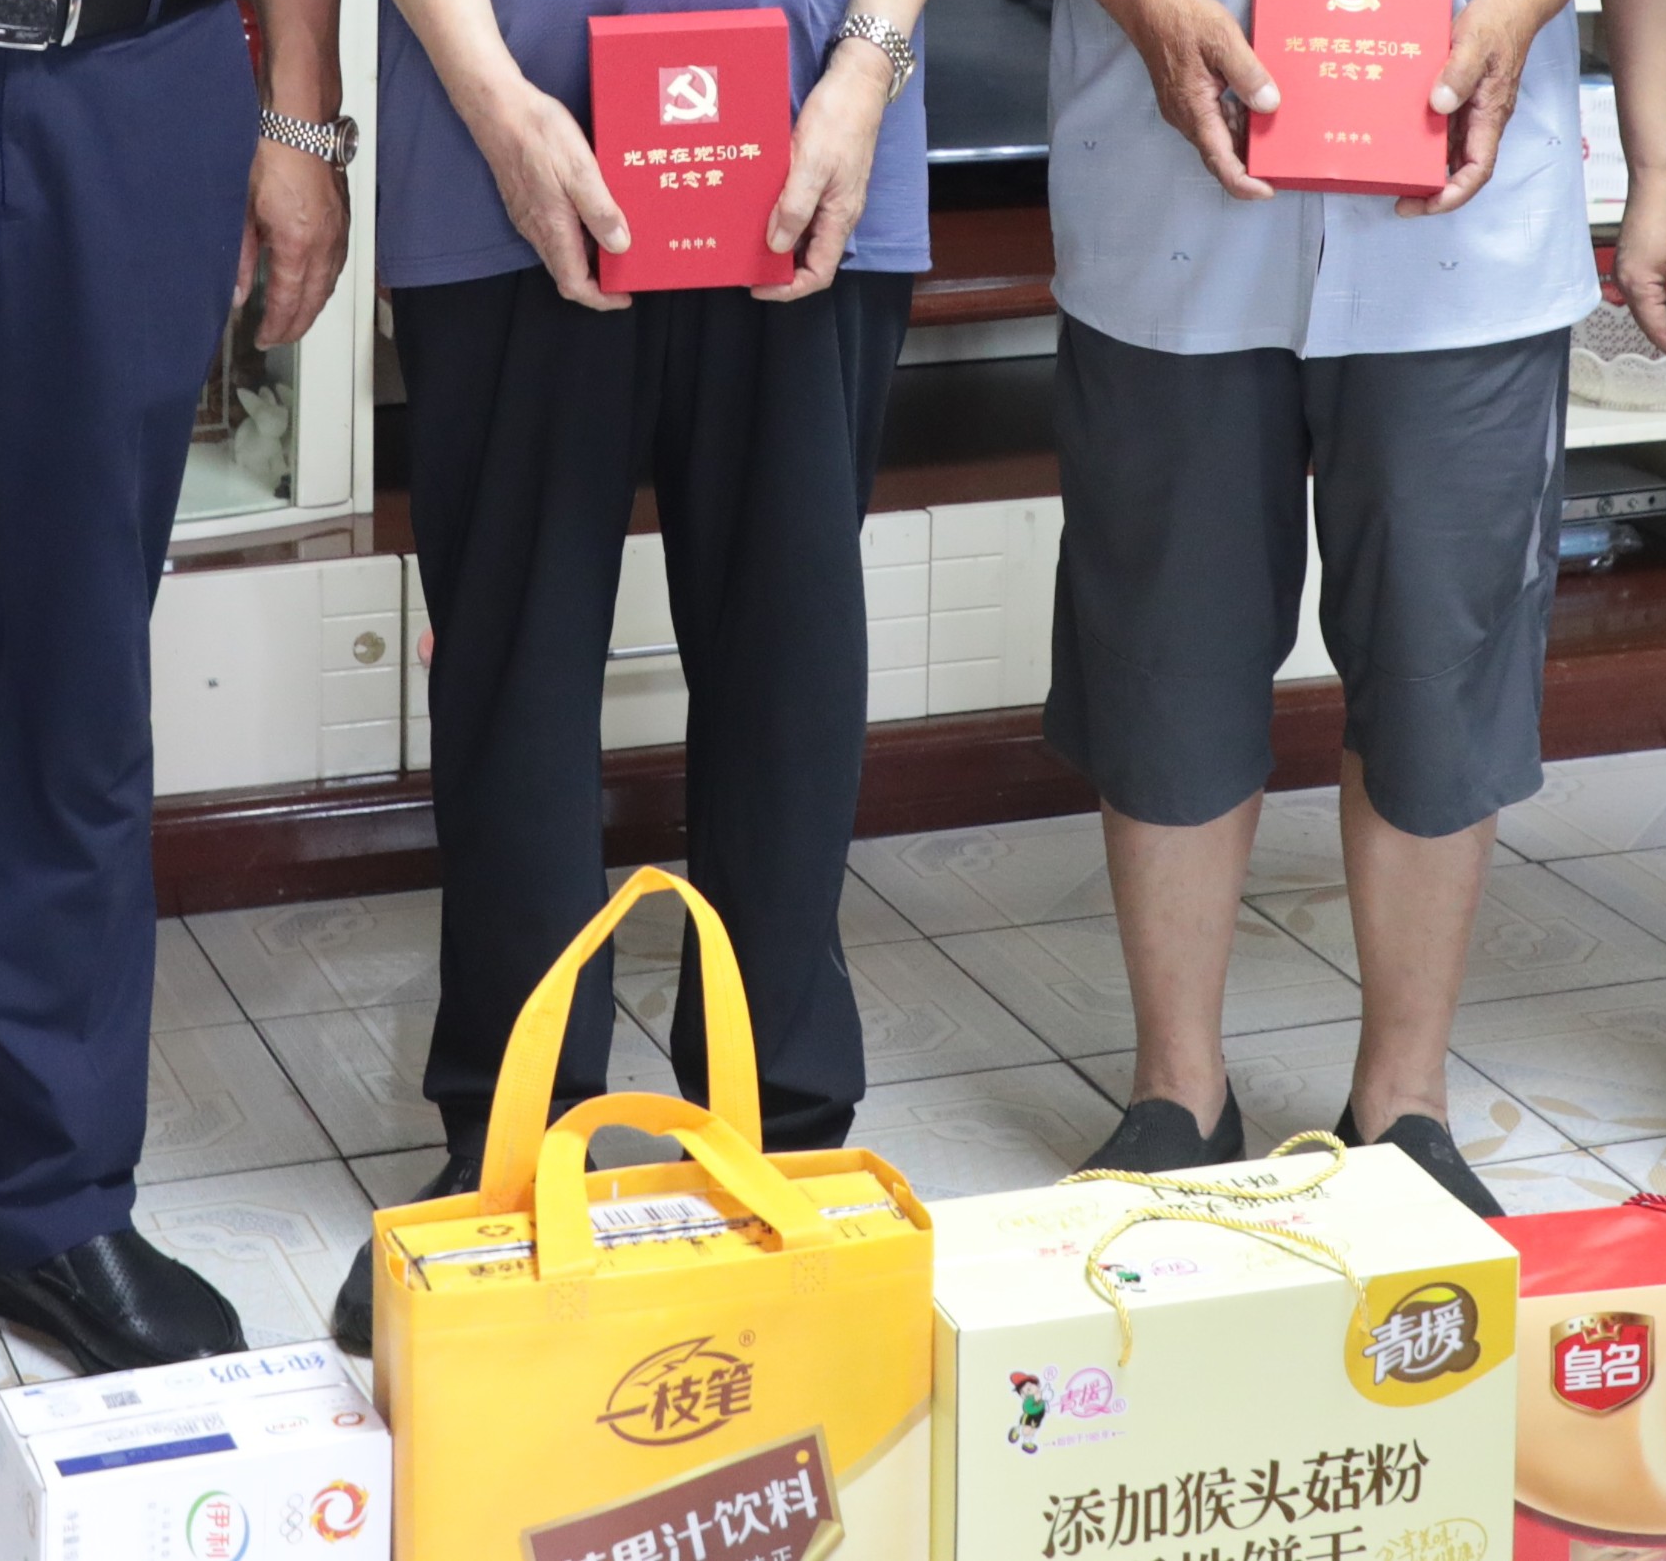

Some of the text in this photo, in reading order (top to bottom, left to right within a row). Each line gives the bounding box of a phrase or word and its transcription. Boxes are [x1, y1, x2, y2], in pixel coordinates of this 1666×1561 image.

[1284, 36, 1422, 59] 光荣在党50年
[1319, 62, 1384, 81] 纪念章
[1324, 131, 1372, 144] 中共中央
[623, 143, 761, 167] 光荣在党50年
[659, 169, 724, 189] 纪念章
[669, 237, 717, 251] 中共中央
[1362, 1298, 1465, 1386] 青援
[1563, 1341, 1640, 1392] 皇名
[594, 1360, 753, 1432] 一枝笔
[1041, 1438, 1430, 1559] 添加猴头菇粉
[205, 1501, 230, 1558] 伊利
